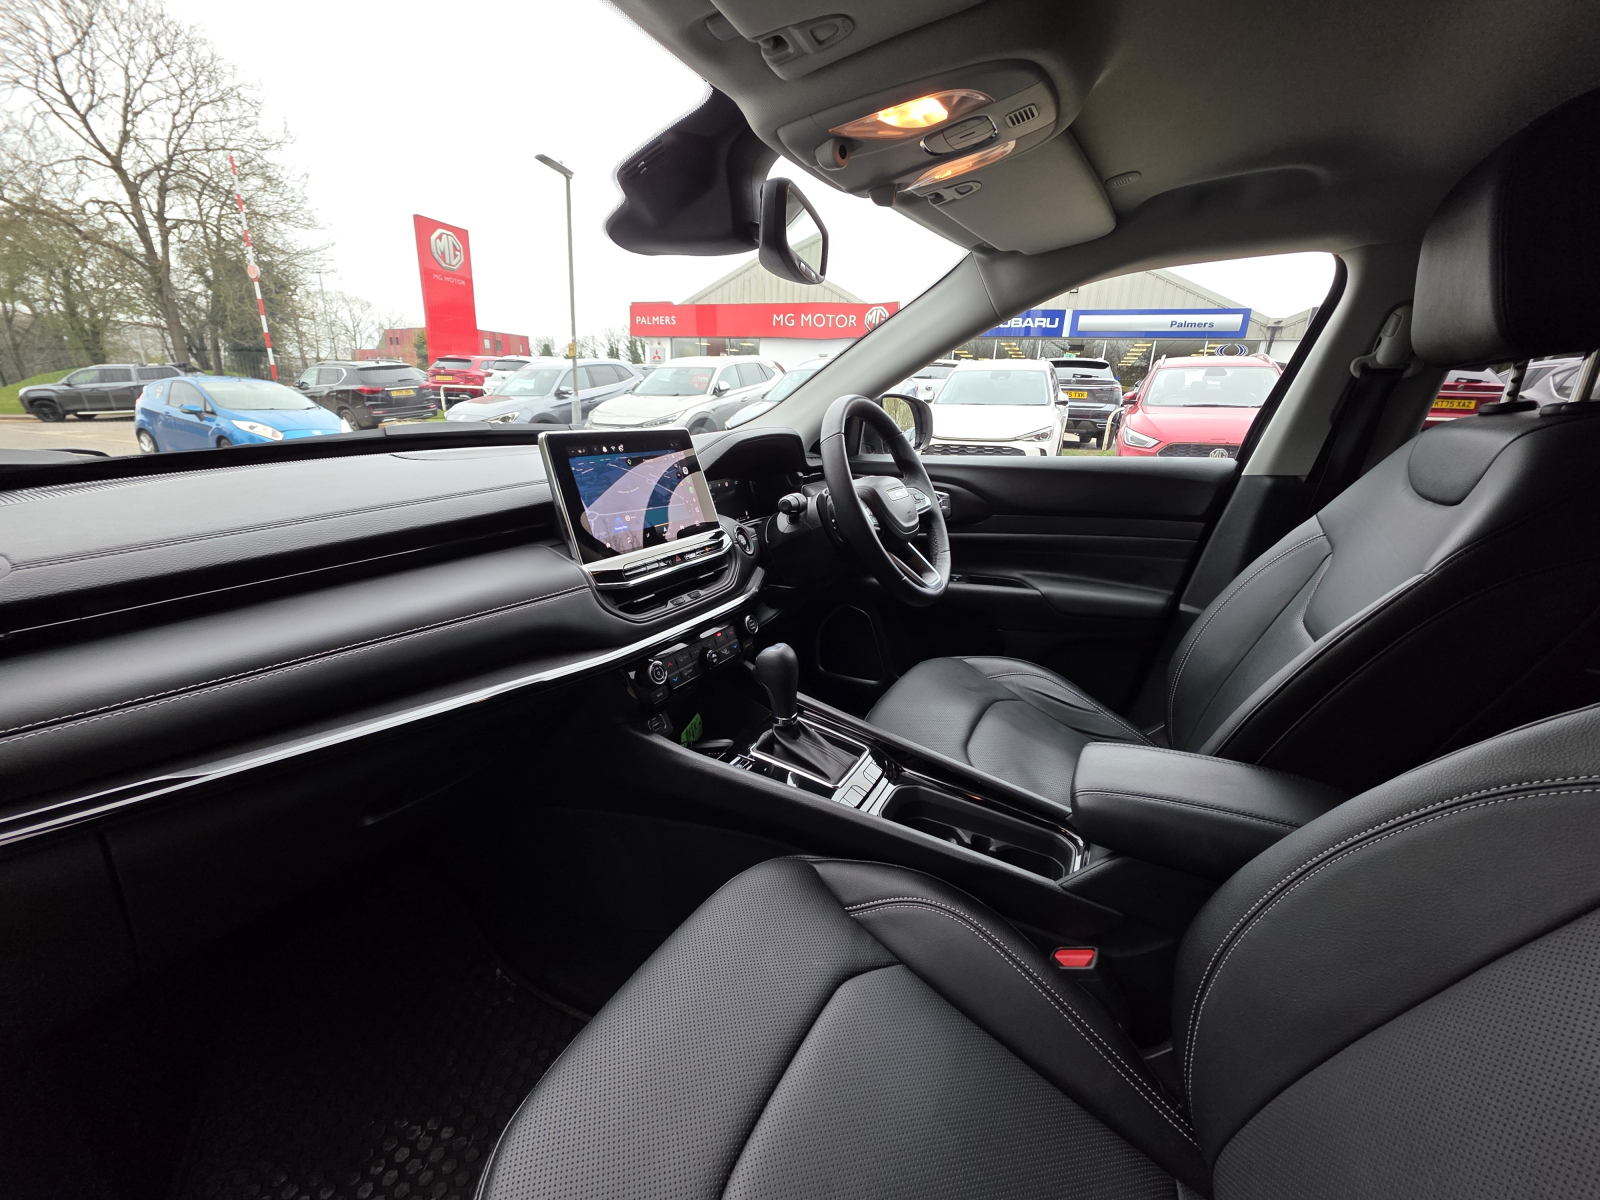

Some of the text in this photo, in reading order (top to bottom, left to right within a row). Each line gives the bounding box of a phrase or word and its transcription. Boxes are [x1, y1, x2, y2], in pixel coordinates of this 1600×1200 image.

[433, 232, 462, 267] MG
[432, 273, 466, 286] MG MOTOR
[635, 315, 677, 325] PALMERS
[772, 313, 857, 328] MG MOTOR
[996, 317, 1060, 329] UBARU
[1169, 320, 1215, 328] Palmers
